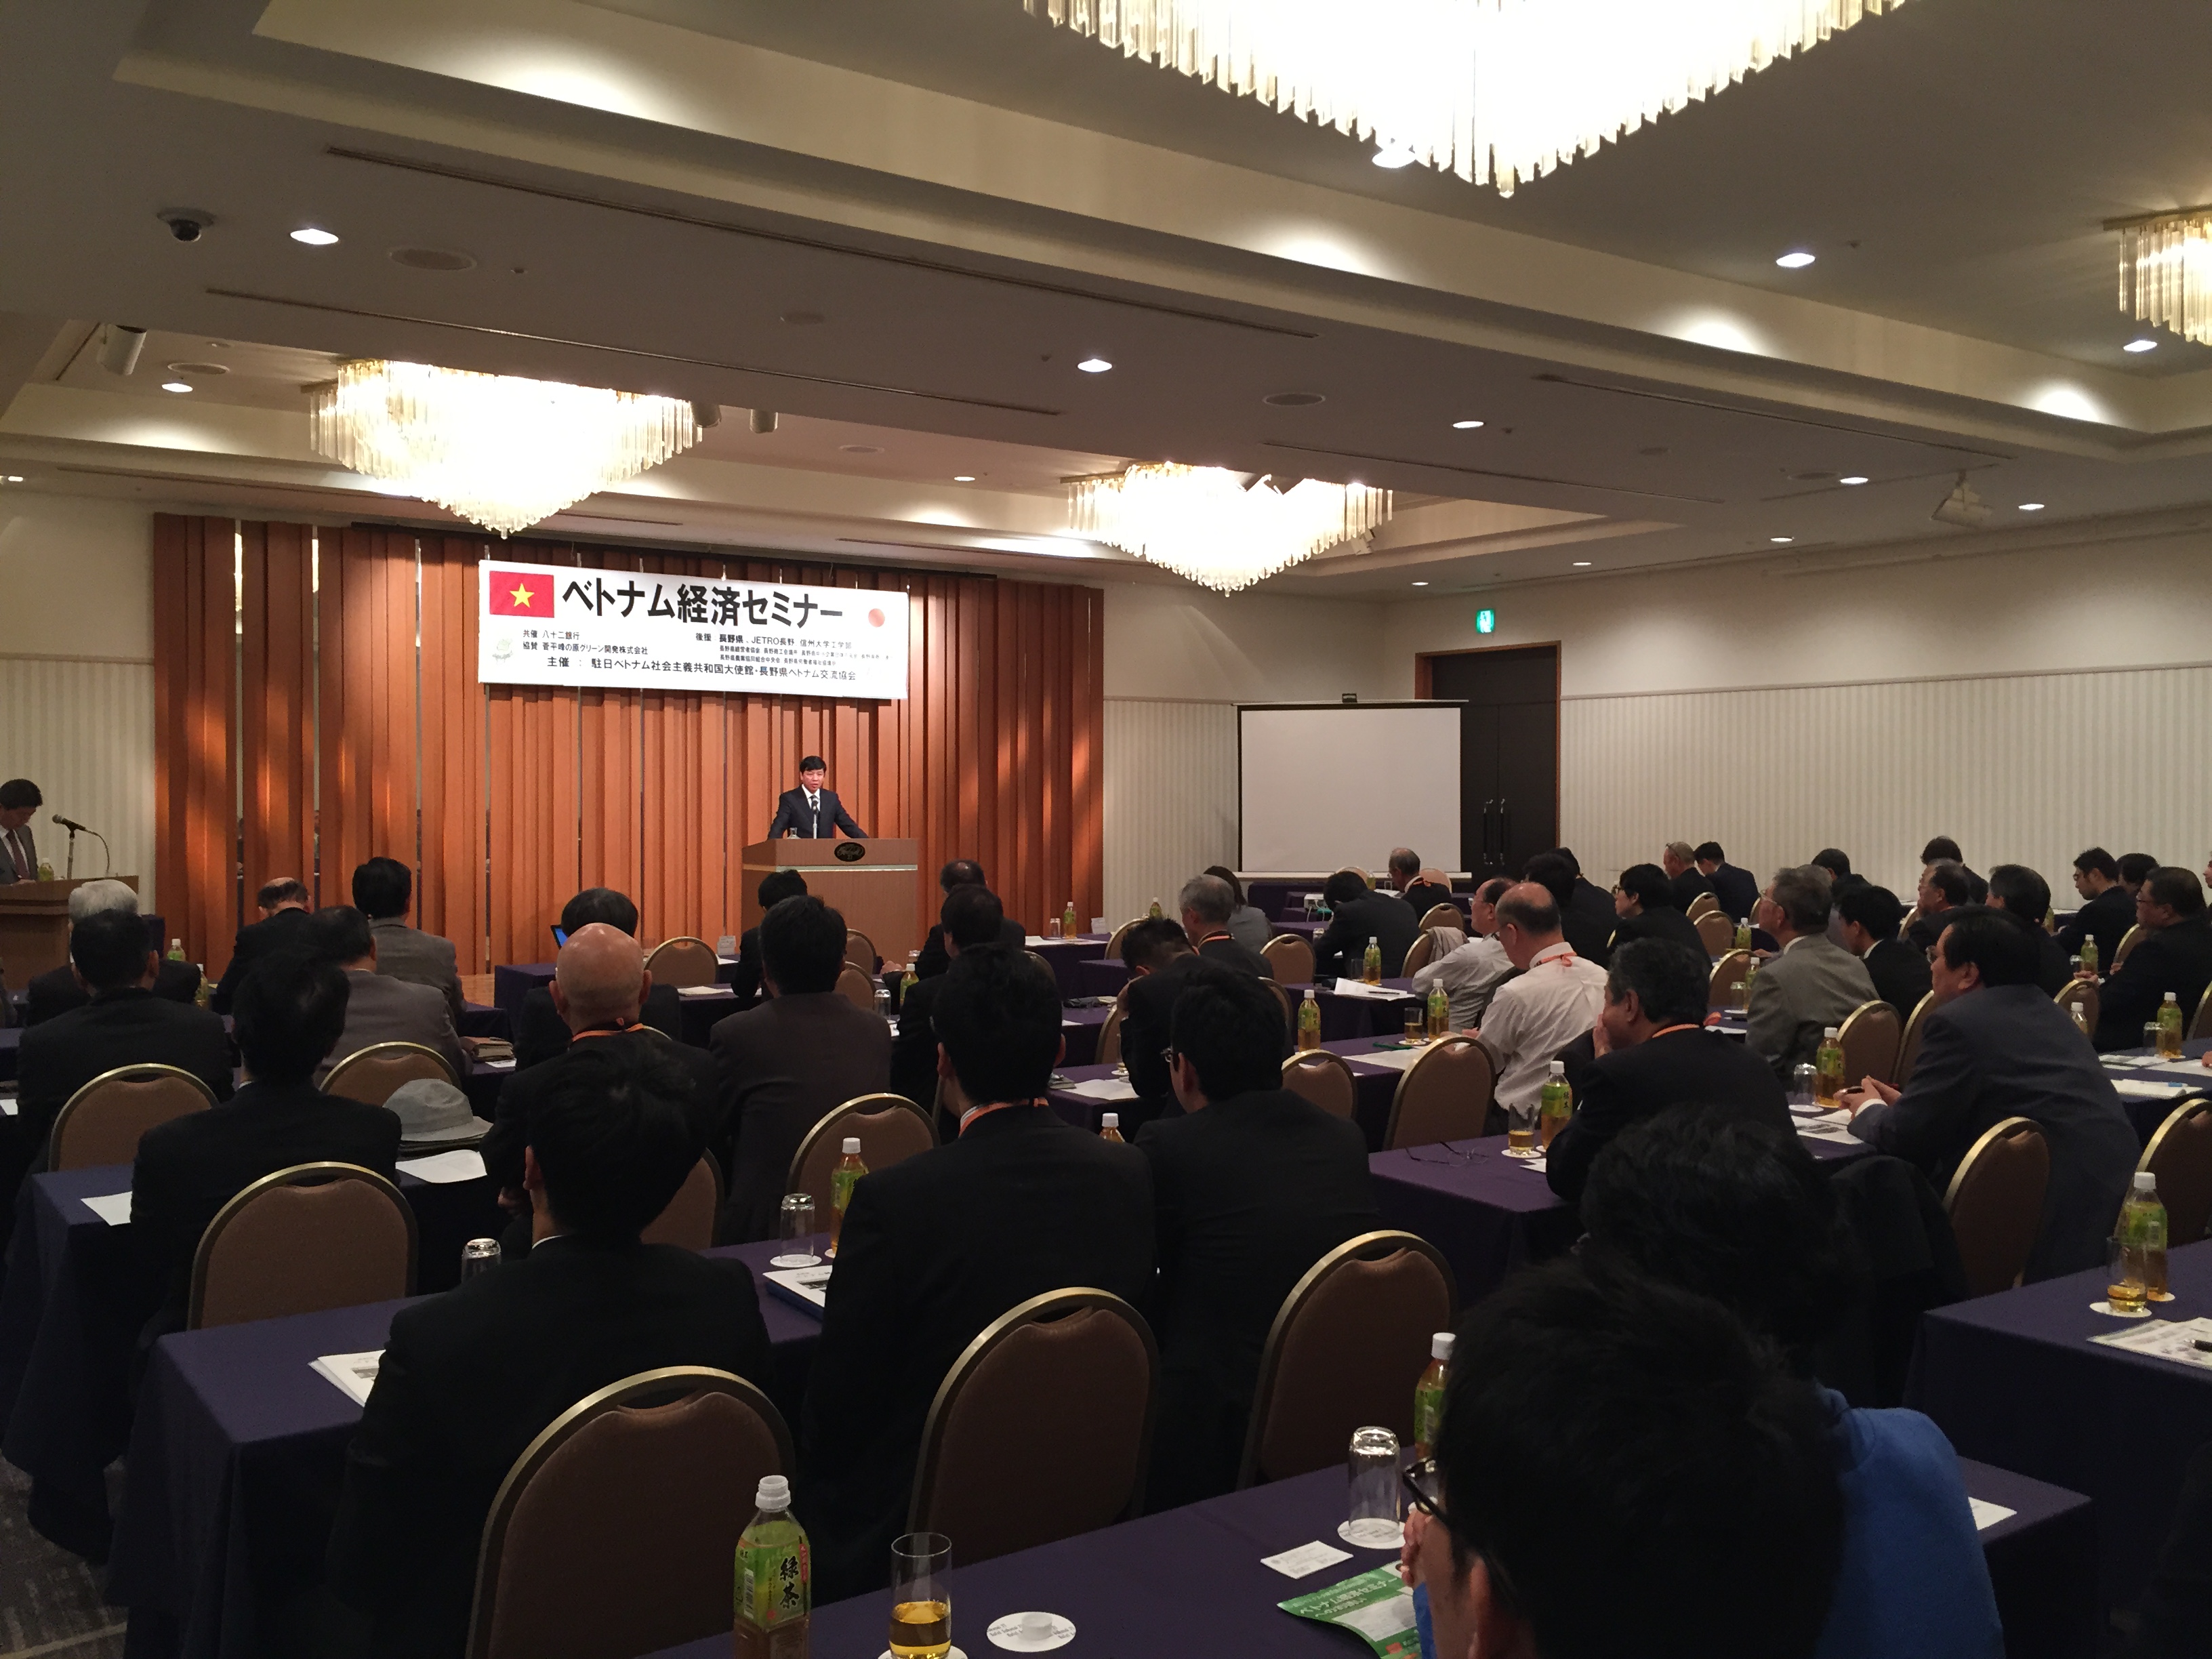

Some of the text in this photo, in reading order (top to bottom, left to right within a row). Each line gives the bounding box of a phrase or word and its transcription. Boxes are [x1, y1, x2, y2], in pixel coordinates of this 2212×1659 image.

[562, 577, 842, 628] ベトナム経済セミナー
[541, 630, 580, 640] 八十二銀行
